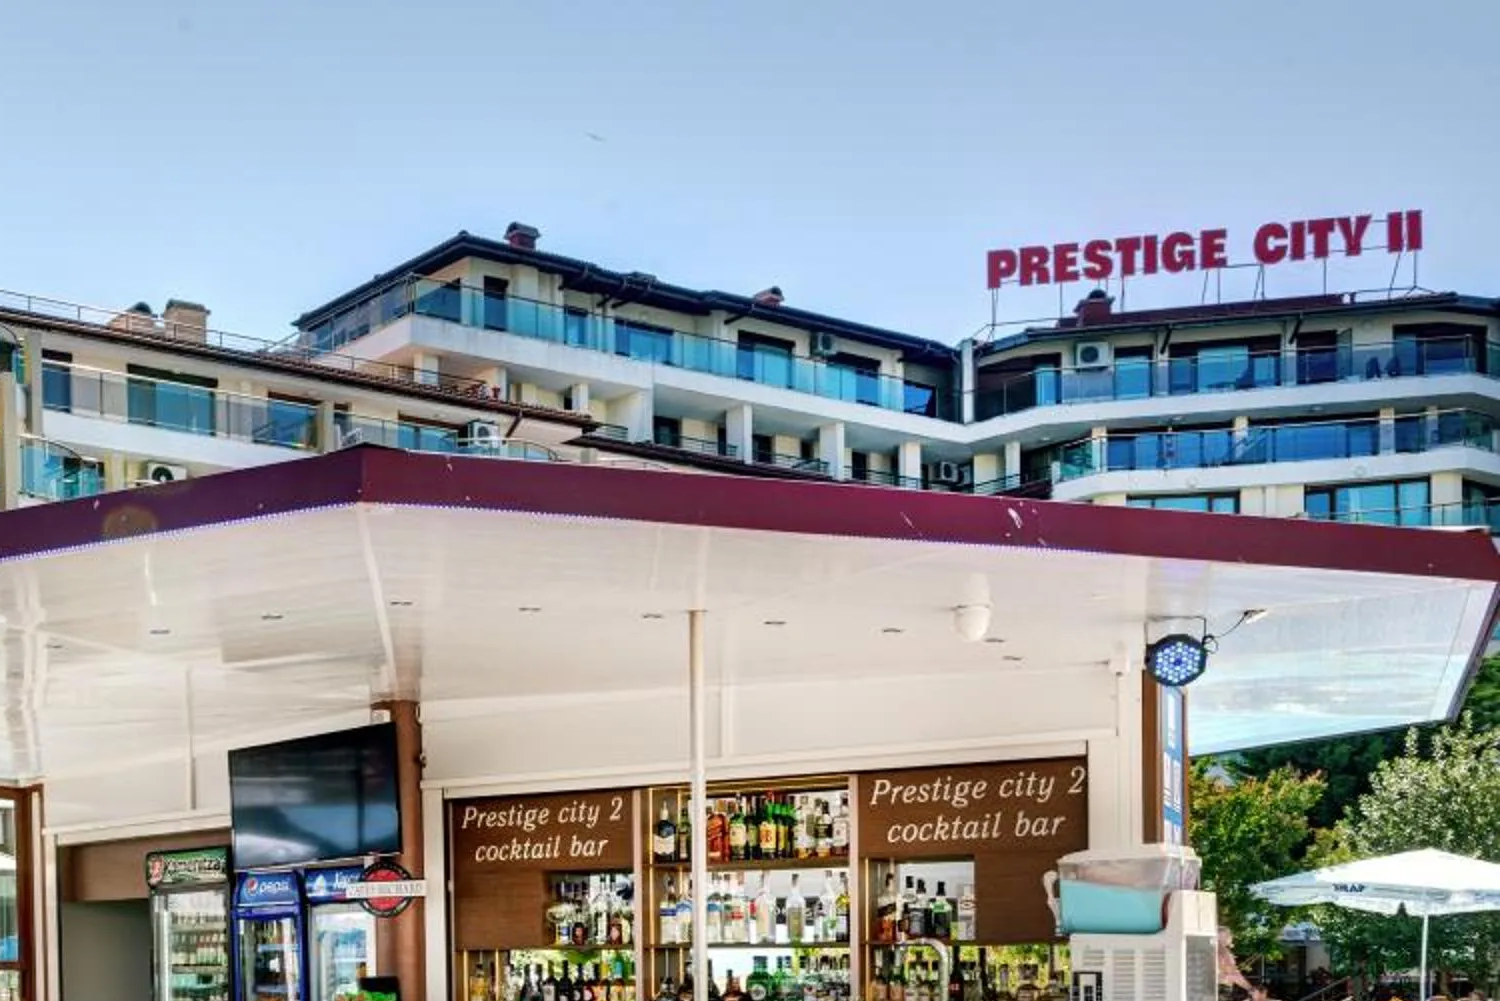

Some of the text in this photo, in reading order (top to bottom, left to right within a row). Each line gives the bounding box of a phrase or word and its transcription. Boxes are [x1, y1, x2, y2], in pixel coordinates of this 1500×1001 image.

[987, 210, 1422, 289] PRESTIGE CITY II
[870, 765, 1086, 807] Prestige city 2
[462, 797, 623, 832] Prestige city 2
[887, 810, 1066, 843] cocktail bar
[475, 835, 609, 862] cocktail bar
[259, 878, 291, 896] pepsi
